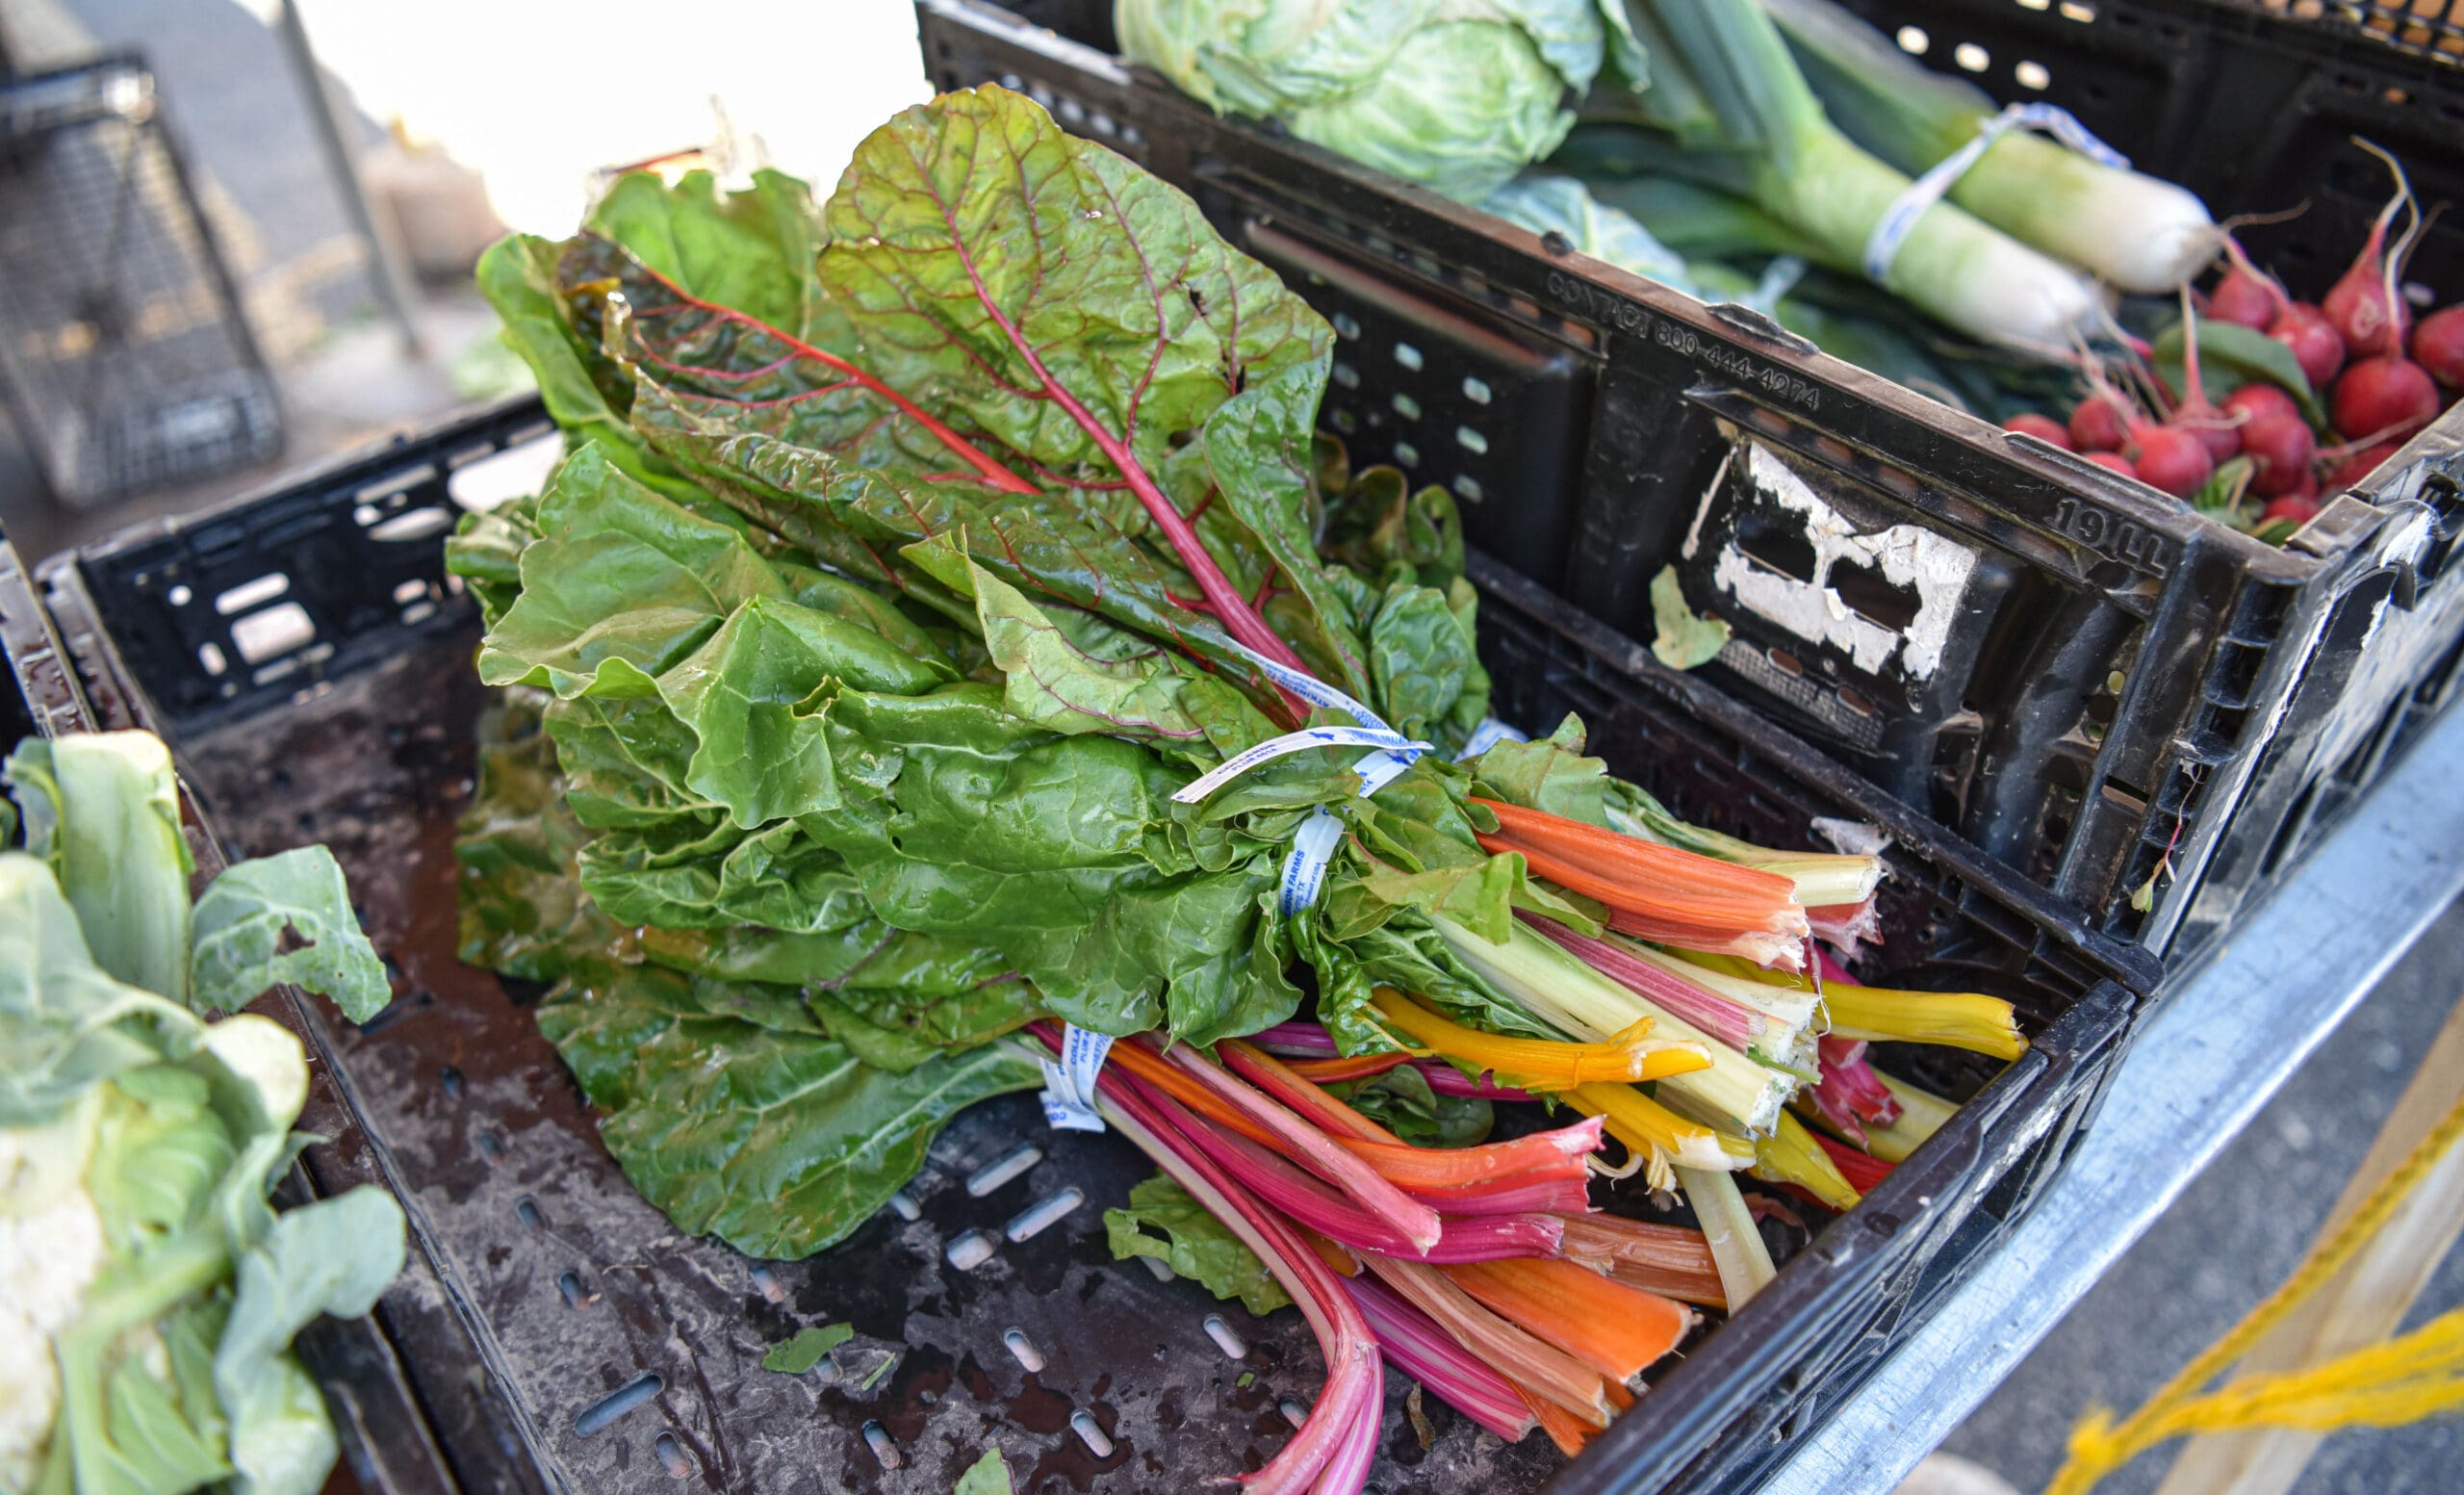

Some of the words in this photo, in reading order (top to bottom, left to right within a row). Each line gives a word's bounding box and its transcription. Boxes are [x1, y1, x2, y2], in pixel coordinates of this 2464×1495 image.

[1547, 271, 1653, 339] CONTACT
[1654, 321, 1821, 411] 800-444-4274
[1289, 849, 1305, 887] FARMS
[1313, 862, 1322, 874] USA
[1297, 880, 1306, 892] TX
